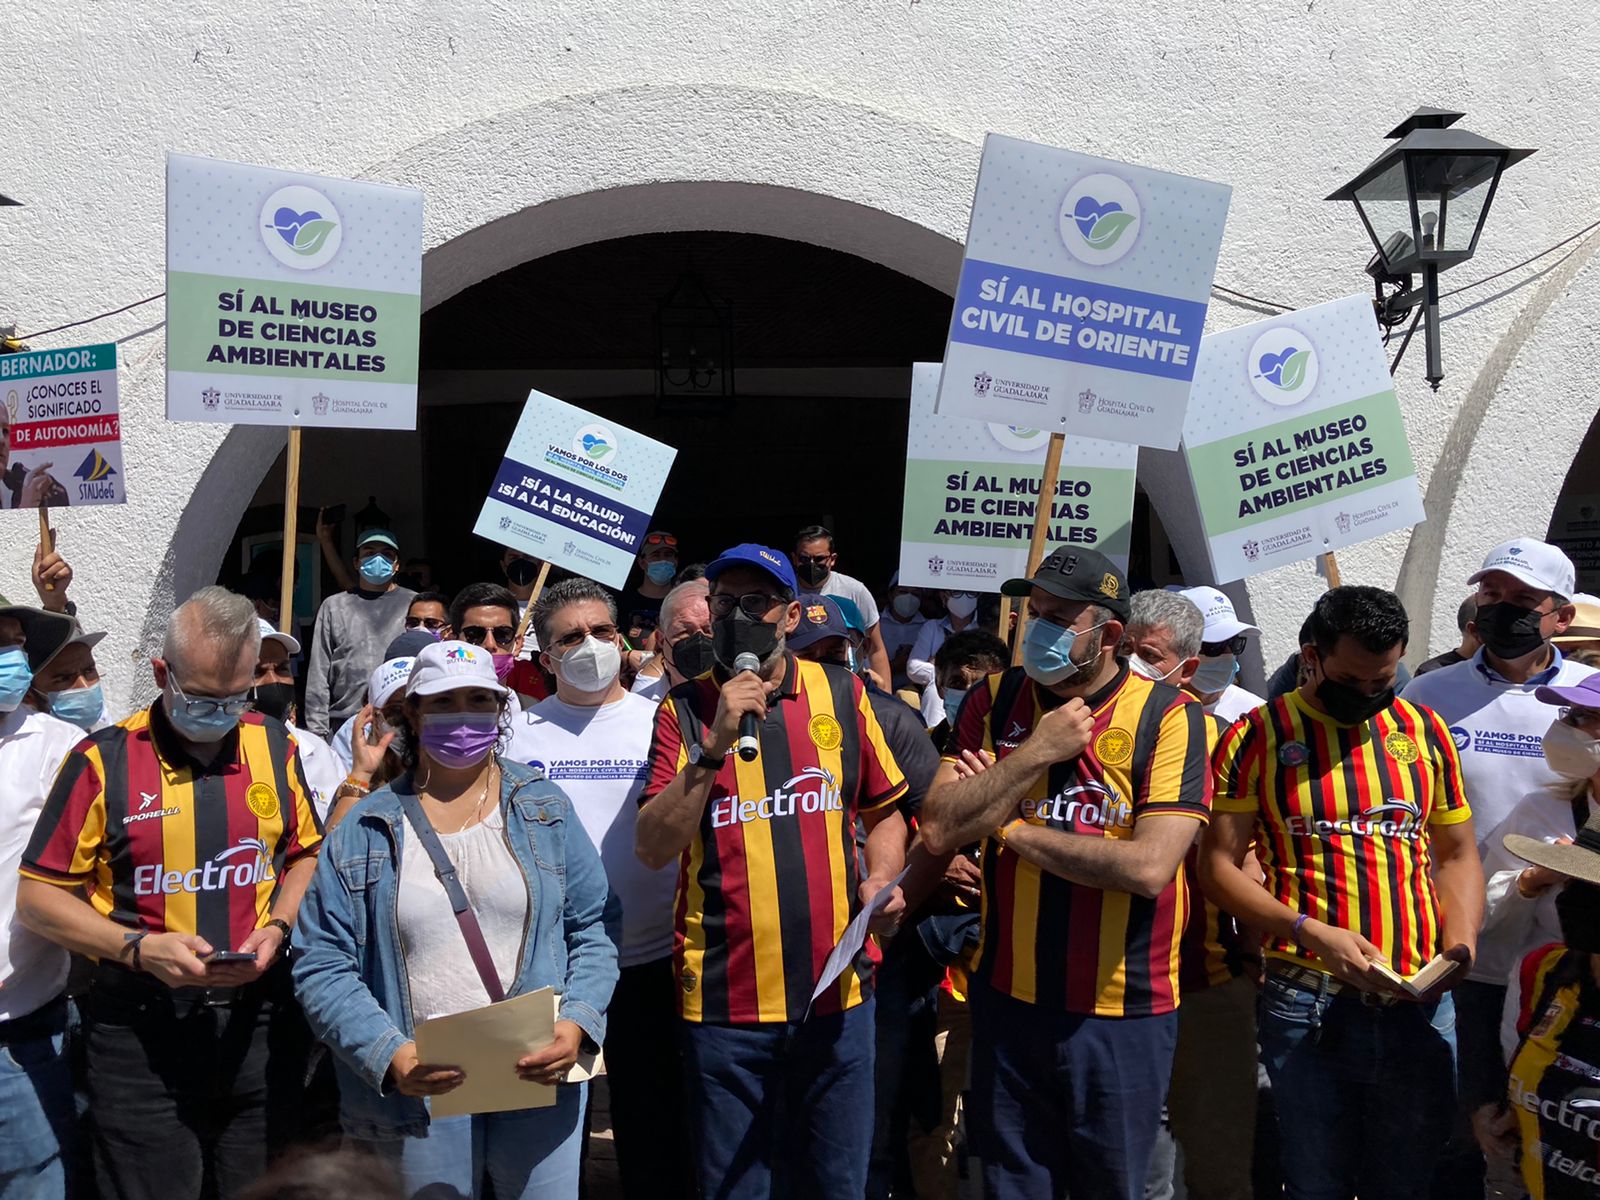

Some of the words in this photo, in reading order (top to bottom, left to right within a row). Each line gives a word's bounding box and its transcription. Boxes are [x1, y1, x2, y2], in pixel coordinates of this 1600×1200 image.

[218, 289, 245, 312] SÍ
[250, 295, 284, 316] AL
[291, 299, 377, 323] MUSEO
[979, 276, 1009, 303] SÍ
[1010, 285, 1046, 311] AL
[1051, 292, 1181, 335] HOSPITAL
[219, 319, 253, 339] DE
[261, 322, 377, 347] CIENCIAS
[961, 307, 1029, 338] CIVIL
[1035, 320, 1073, 346] DE
[1077, 328, 1190, 365] ORIENTE
[1, 350, 97, 377] BERNADOR:
[206, 345, 386, 372] AMBIENTALES
[27, 381, 87, 403] ¿CONOCES
[91, 380, 102, 394] EL
[224, 393, 272, 401] UNIVERSIDAD
[993, 385, 1048, 401] GUADALAJARA
[995, 378, 1040, 391] UNIVERSIDAD
[28, 400, 101, 419] SIGNIFICADO
[224, 399, 282, 408] GUADALAJARA
[16, 428, 31, 442] DE
[34, 420, 120, 441] AUTONOMÍA?
[1234, 442, 1256, 467] SÍ
[1262, 439, 1291, 460] AL
[1293, 415, 1367, 450] MUSEO
[548, 444, 577, 460] VAMOS
[577, 456, 594, 468] POR
[595, 464, 610, 474] LOS
[611, 470, 628, 481] DOS
[1239, 468, 1271, 491] DE
[1275, 437, 1374, 480] CIENCIAS
[79, 482, 114, 500] STAUdeG
[946, 471, 969, 491] SÍ
[973, 476, 1003, 493] AL
[1009, 478, 1091, 497] MUEO
[1238, 458, 1387, 518] AMBIENTALES
[521, 476, 540, 491] ¡SÍ
[540, 484, 551, 496] A
[553, 488, 572, 503] LA
[573, 496, 625, 525] SALUD!
[945, 497, 975, 514] DE
[981, 500, 1089, 520] CIENIAS
[497, 483, 519, 498] ¡SÍ
[516, 492, 528, 503] A
[530, 496, 549, 511] LA
[551, 504, 636, 545] EDUCACIÓN!
[1260, 528, 1302, 545] UNIVERSIDAD
[1262, 532, 1312, 551] GUADALAJARA
[946, 566, 997, 575] GUADALAJARA
[947, 560, 989, 569] UNIVERSIDAD
[1475, 730, 1515, 740] VAMOS
[1518, 735, 1542, 743] POR
[711, 783, 843, 828] Electrolit
[1020, 794, 1133, 827] ectrolit
[1285, 815, 1421, 839] Electrolit
[134, 855, 275, 895] Electrolit
